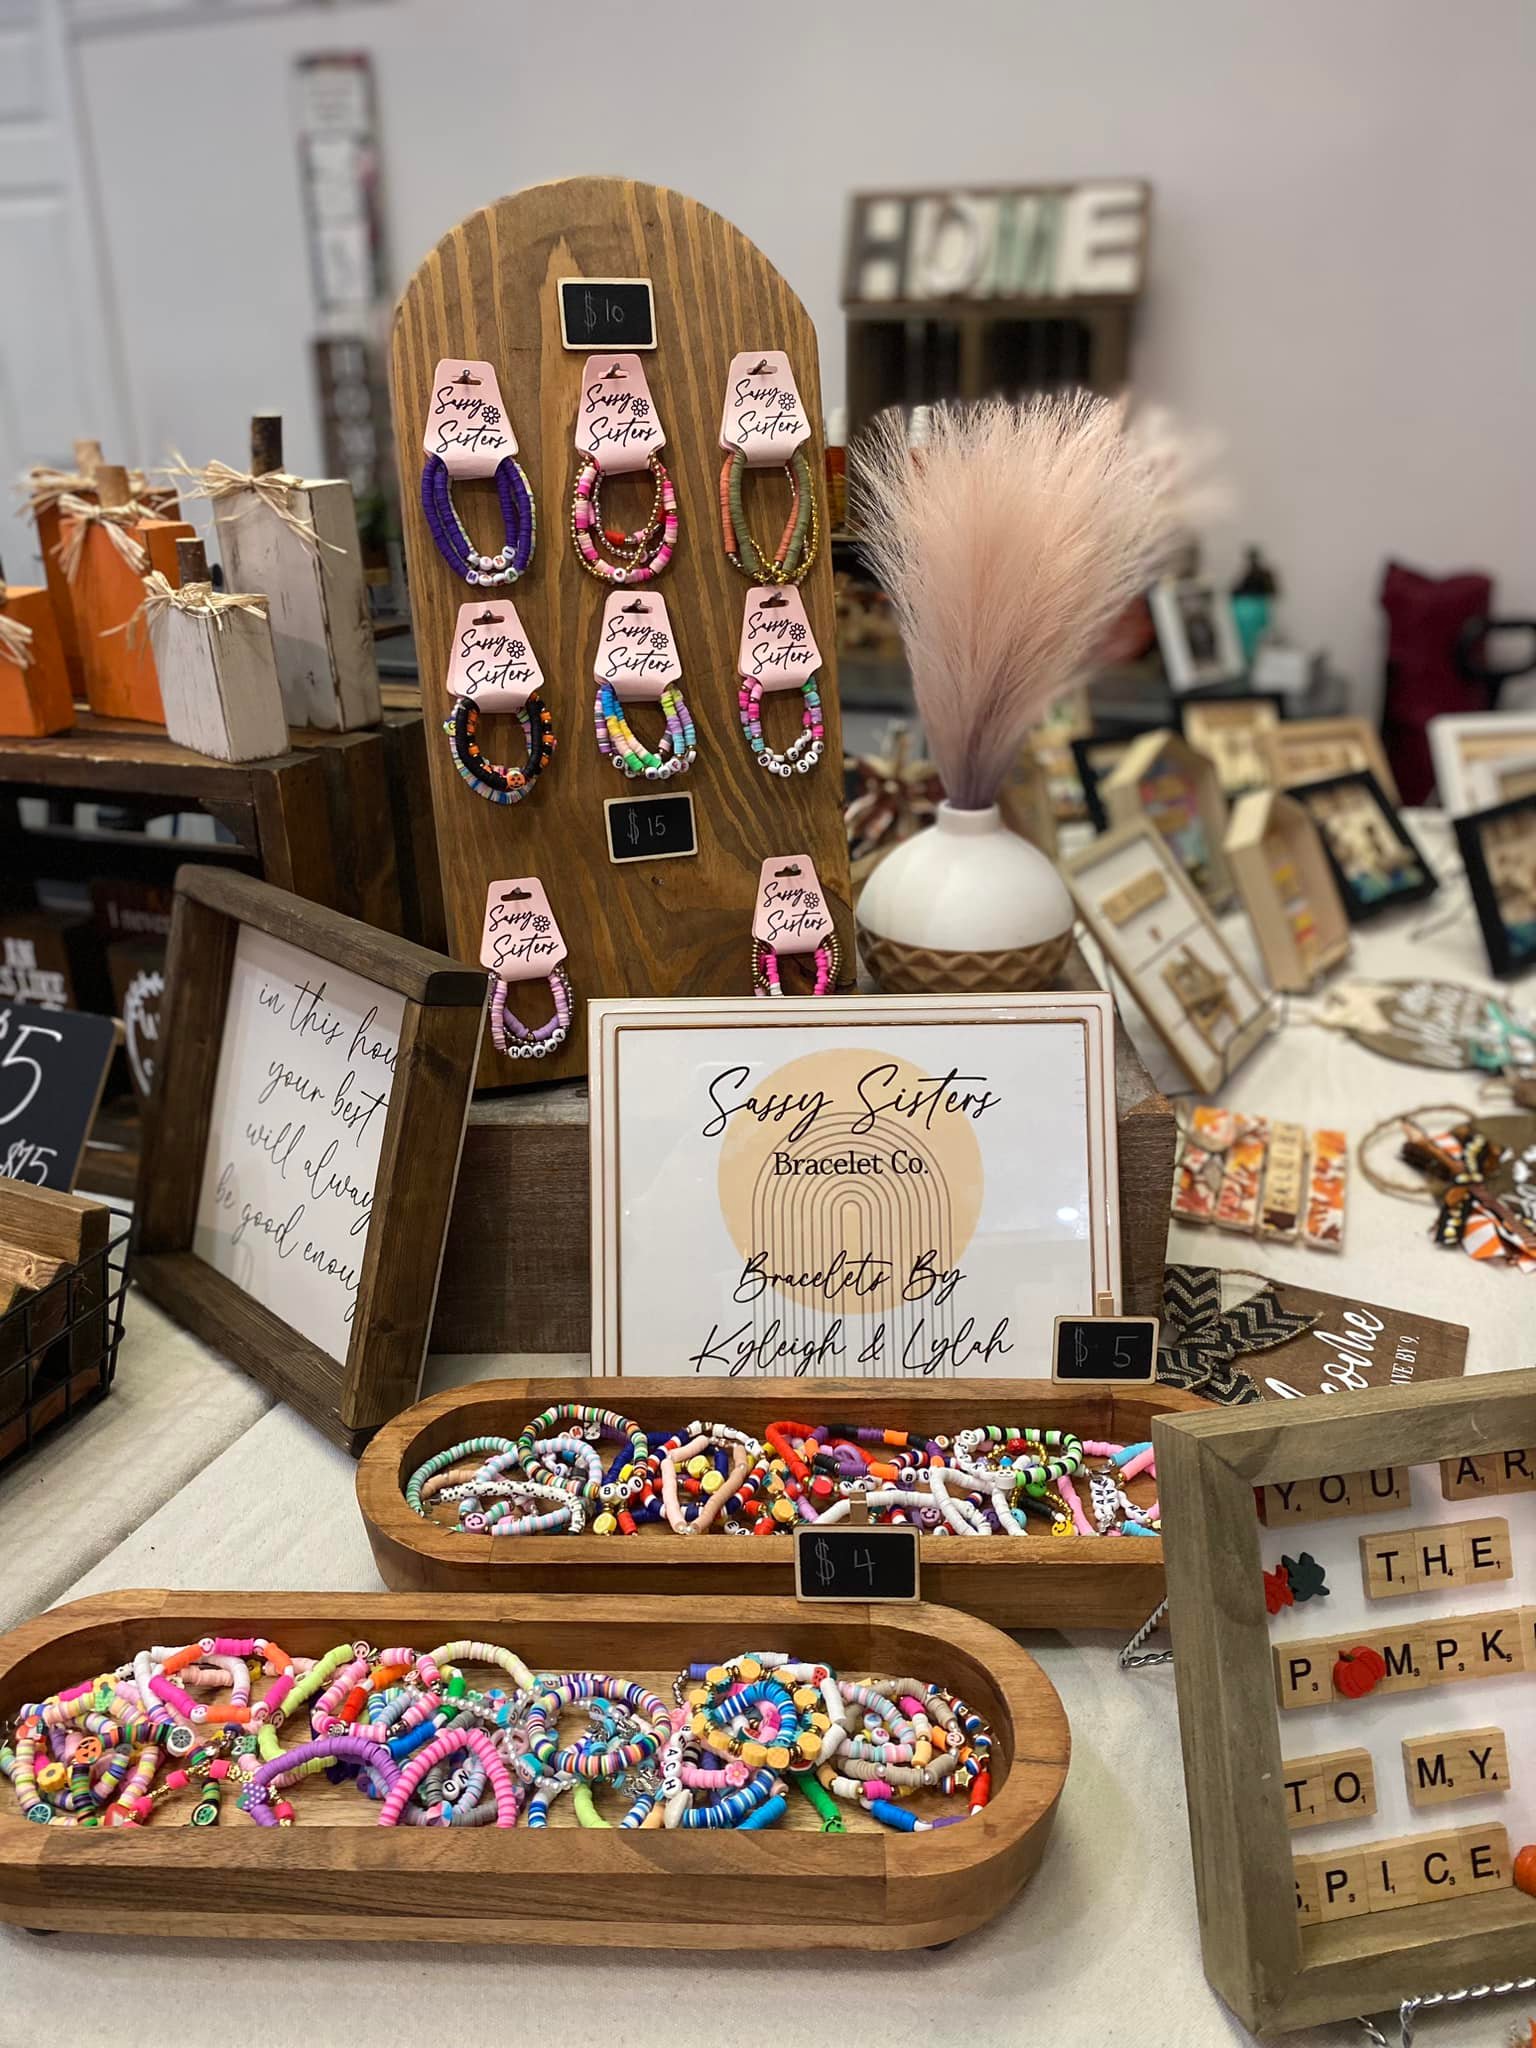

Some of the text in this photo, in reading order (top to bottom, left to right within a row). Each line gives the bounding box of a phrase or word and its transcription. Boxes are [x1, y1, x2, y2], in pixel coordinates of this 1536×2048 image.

[435, 386, 484, 423] Sassy
[587, 383, 634, 418] Sassy
[735, 379, 781, 412] Sassy
[435, 419, 508, 453] Sisters
[588, 417, 657, 451] Sisters
[738, 410, 804, 444] Sisters
[607, 616, 652, 647] Sassy
[748, 611, 792, 641] Sassy
[461, 629, 508, 662] Sassy
[608, 647, 674, 678] Sisters
[752, 642, 815, 674] Sisters
[465, 661, 535, 694] Sisters
[764, 883, 806, 908] Sassy
[489, 904, 536, 933] Sassy
[767, 910, 827, 941] Sisters
[493, 934, 560, 968] Sisters
[259, 984, 285, 1014] in
[290, 980, 344, 1045] this
[258, 1061, 390, 1147] your best
[703, 1064, 1001, 1142] Sassy Sisters
[247, 1123, 305, 1180] will
[774, 1150, 929, 1176] Bracelet Co.
[216, 1163, 235, 1210] be
[232, 1204, 305, 1259] good
[734, 1249, 967, 1306] Bracelets By
[690, 1317, 1014, 1377] Kyleigh & Lylah
[1272, 1466, 1396, 1511] YOU
[1376, 1536, 1496, 1582] THE
[1284, 1746, 1496, 1814] TO MY
